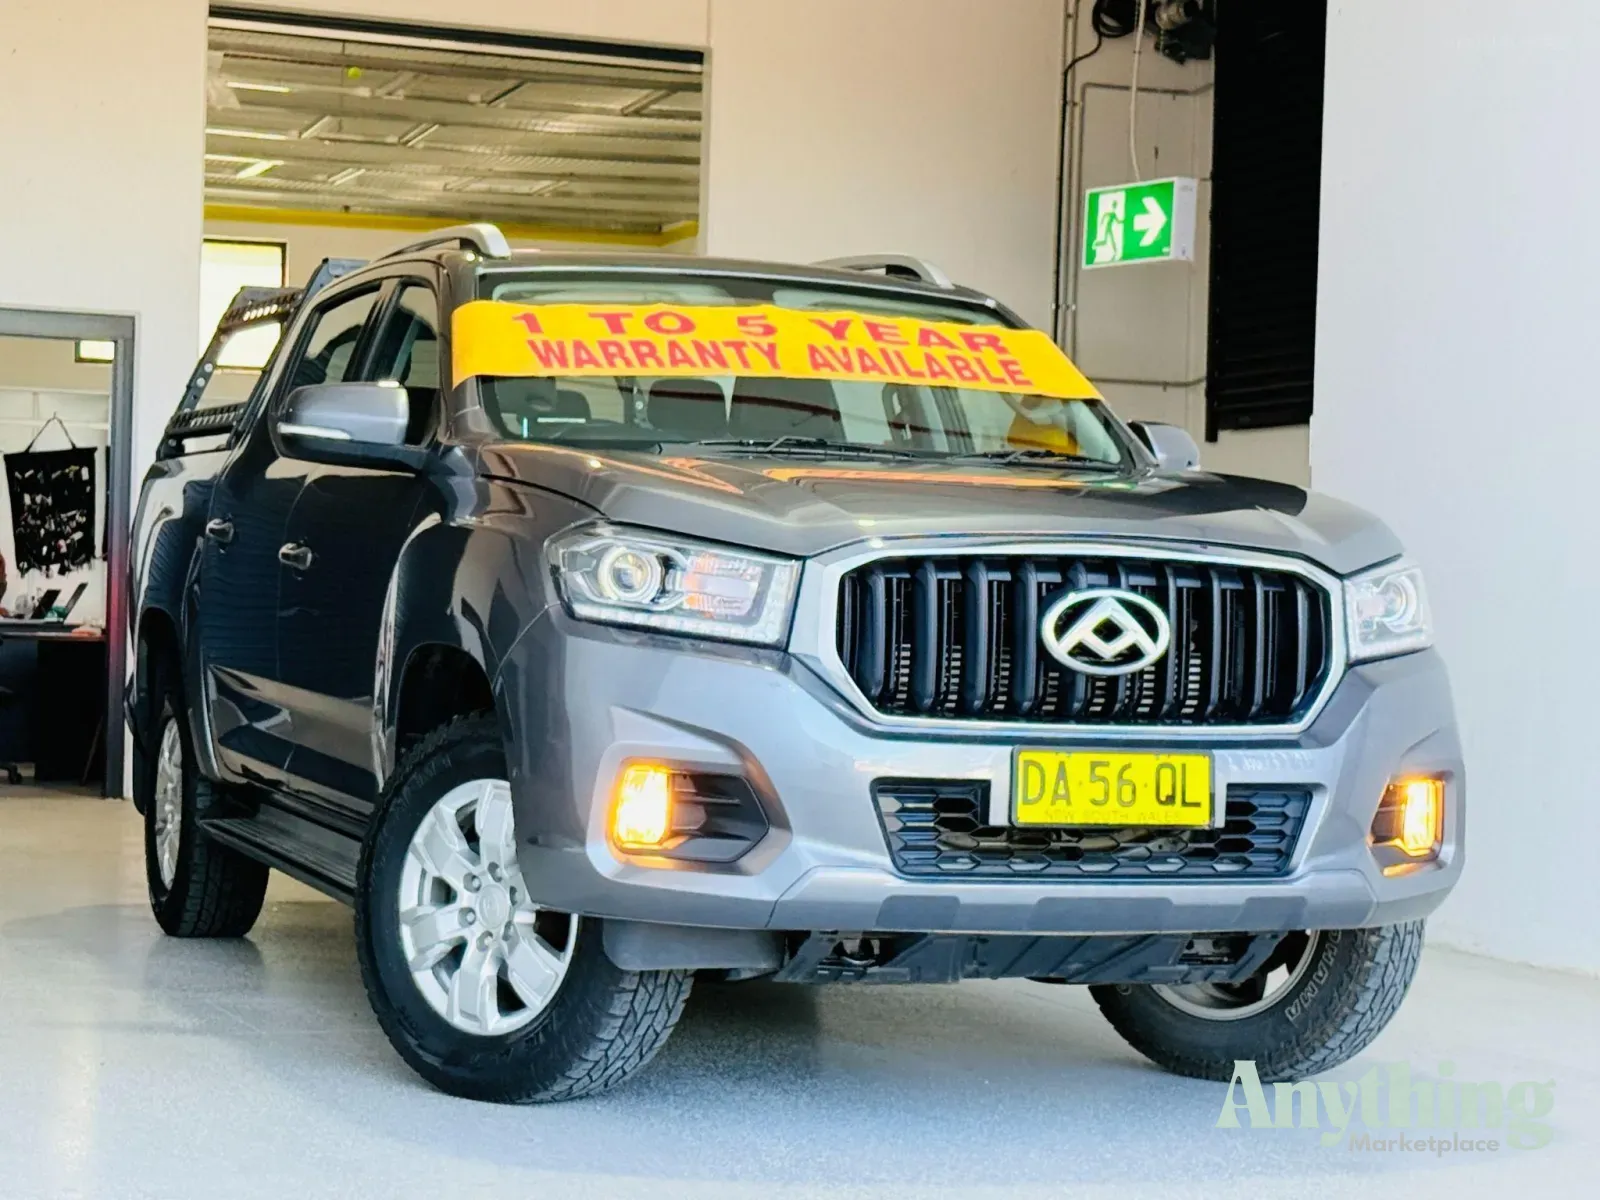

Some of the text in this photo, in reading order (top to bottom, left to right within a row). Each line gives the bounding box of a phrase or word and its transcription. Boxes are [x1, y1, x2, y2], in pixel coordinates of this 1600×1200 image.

[512, 311, 1011, 355] 1 TO 5 YEAR
[527, 340, 1033, 386] WARRANTY AVAILABLE
